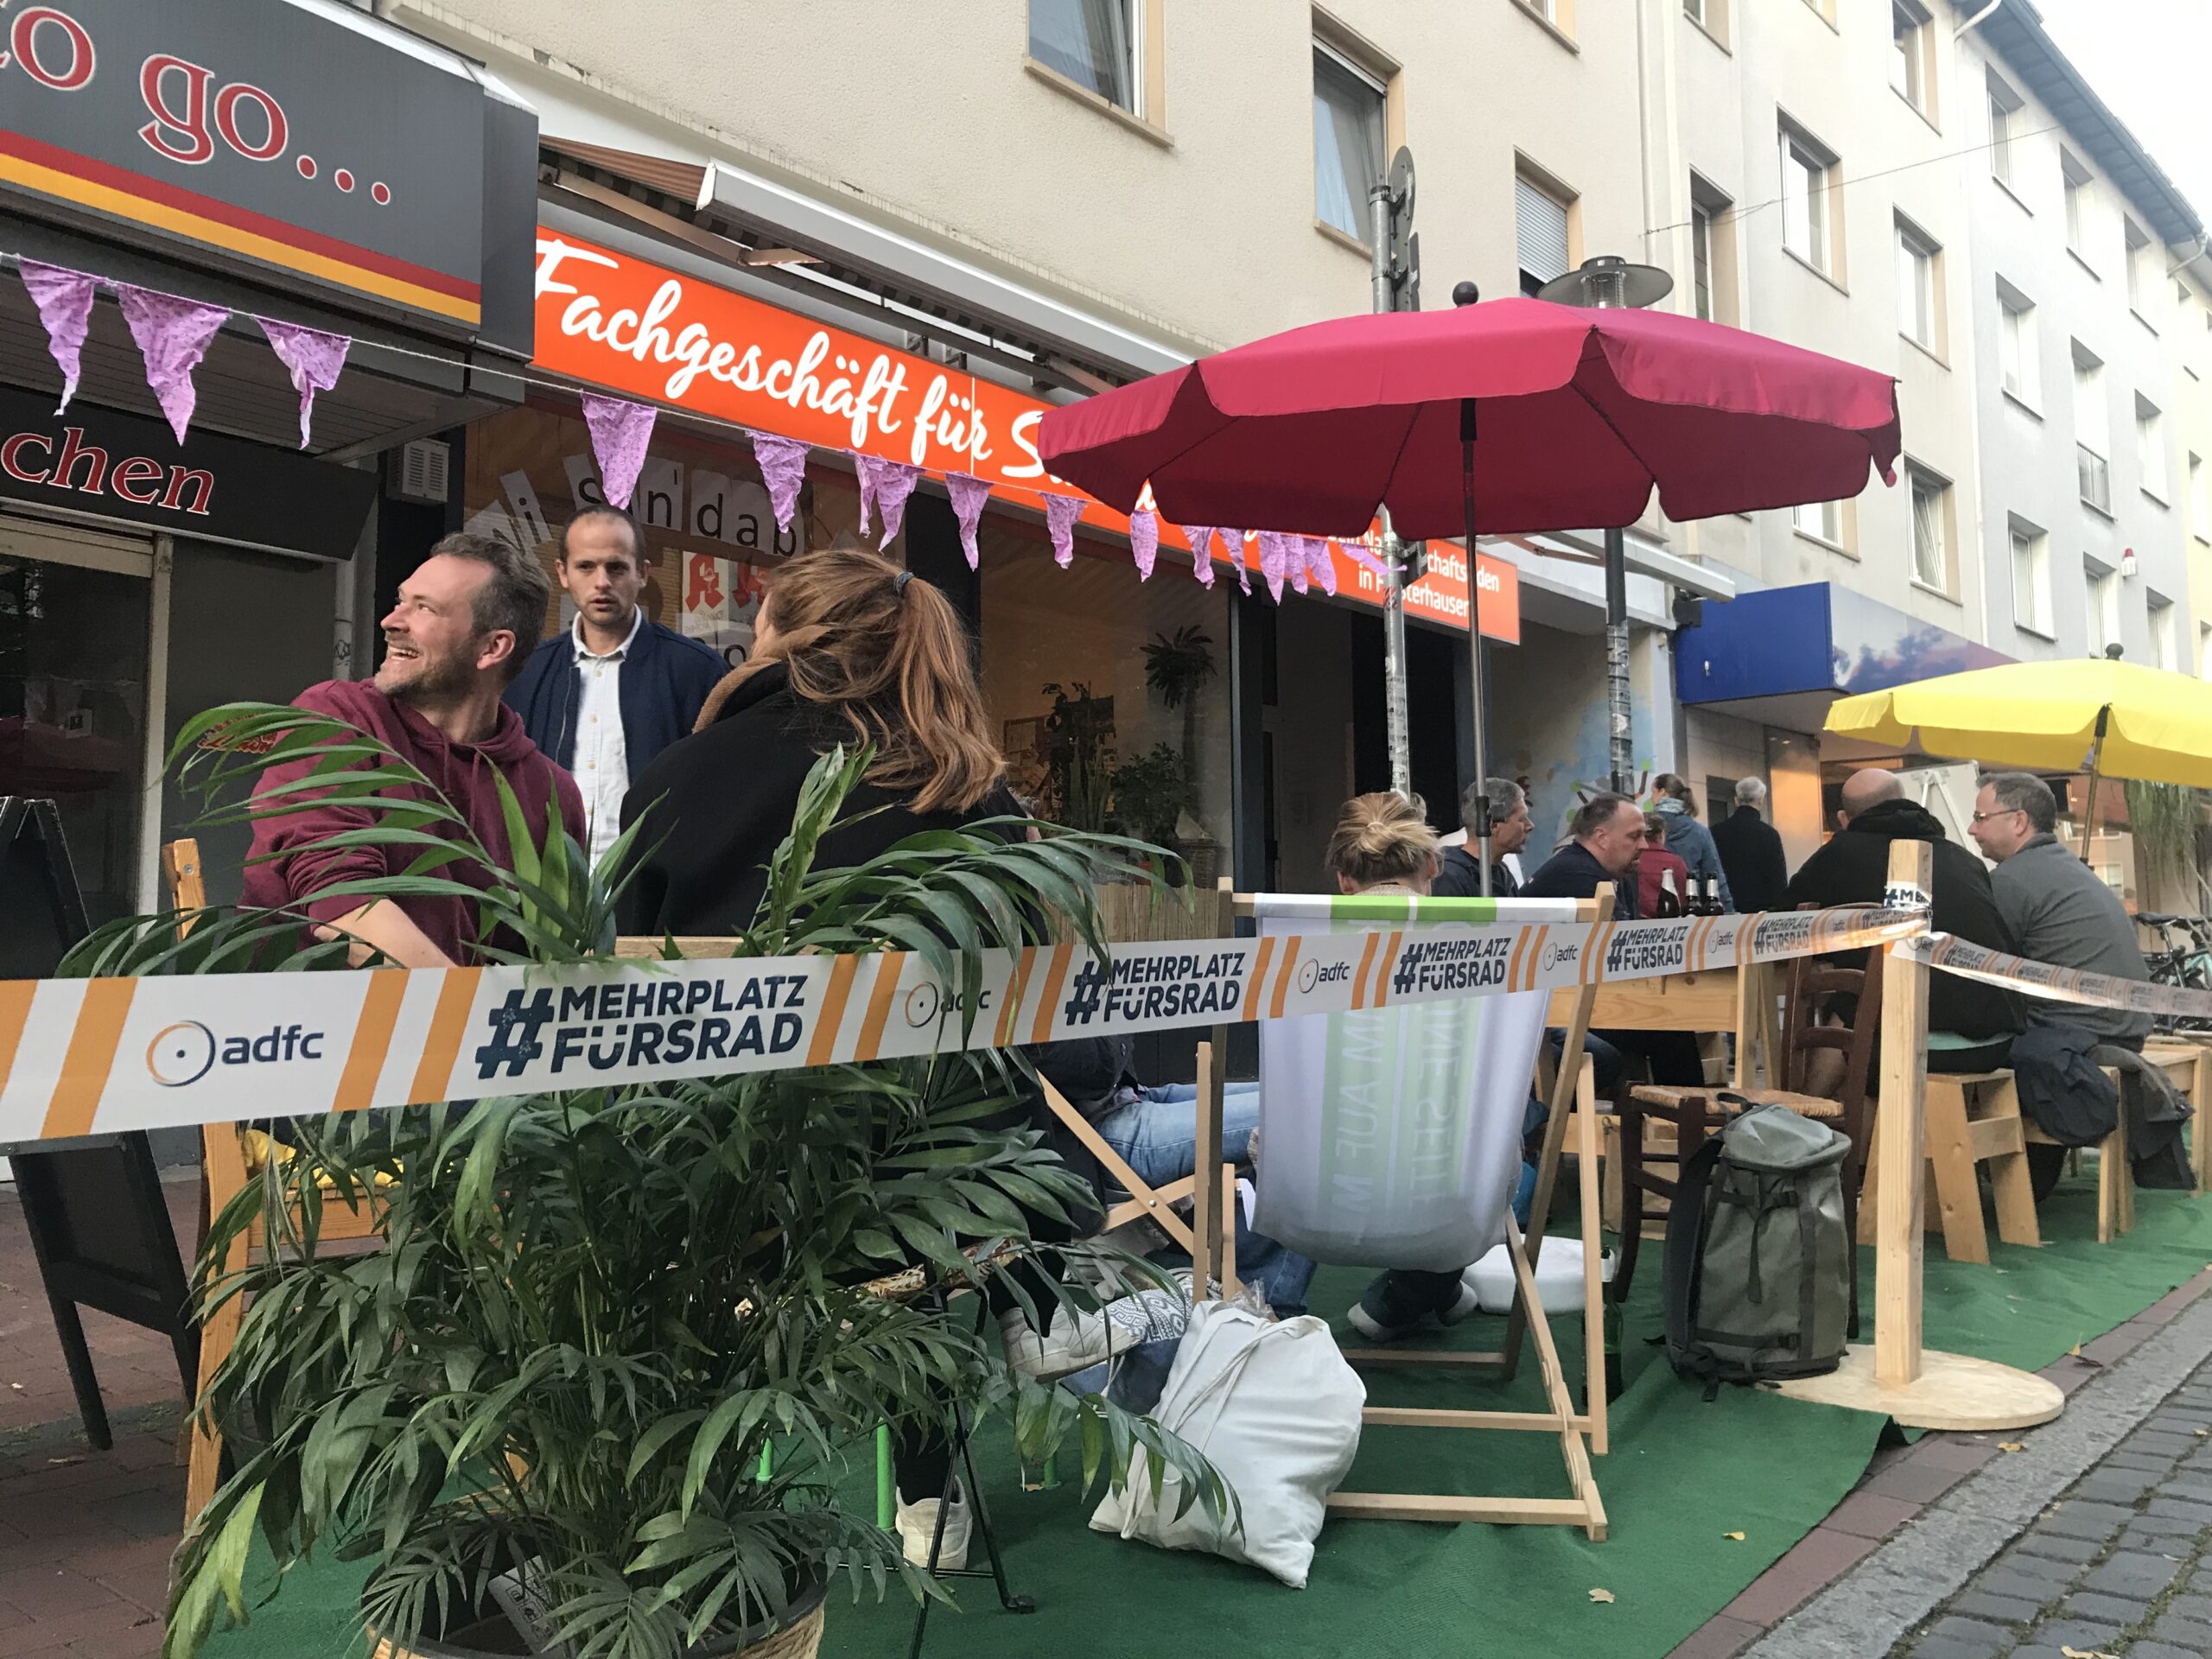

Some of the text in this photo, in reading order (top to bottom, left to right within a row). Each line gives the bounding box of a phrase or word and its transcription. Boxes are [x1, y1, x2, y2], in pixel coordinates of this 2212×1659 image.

[0, 0, 391, 206] o go...
[535, 238, 909, 448] Fachgeschäft
[910, 374, 992, 466] für
[1, 426, 214, 516] chen
[1358, 563, 1372, 591] in
[1318, 961, 1351, 982] adfc
[1556, 945, 1578, 963] adfc
[221, 1025, 325, 1065] adfc
